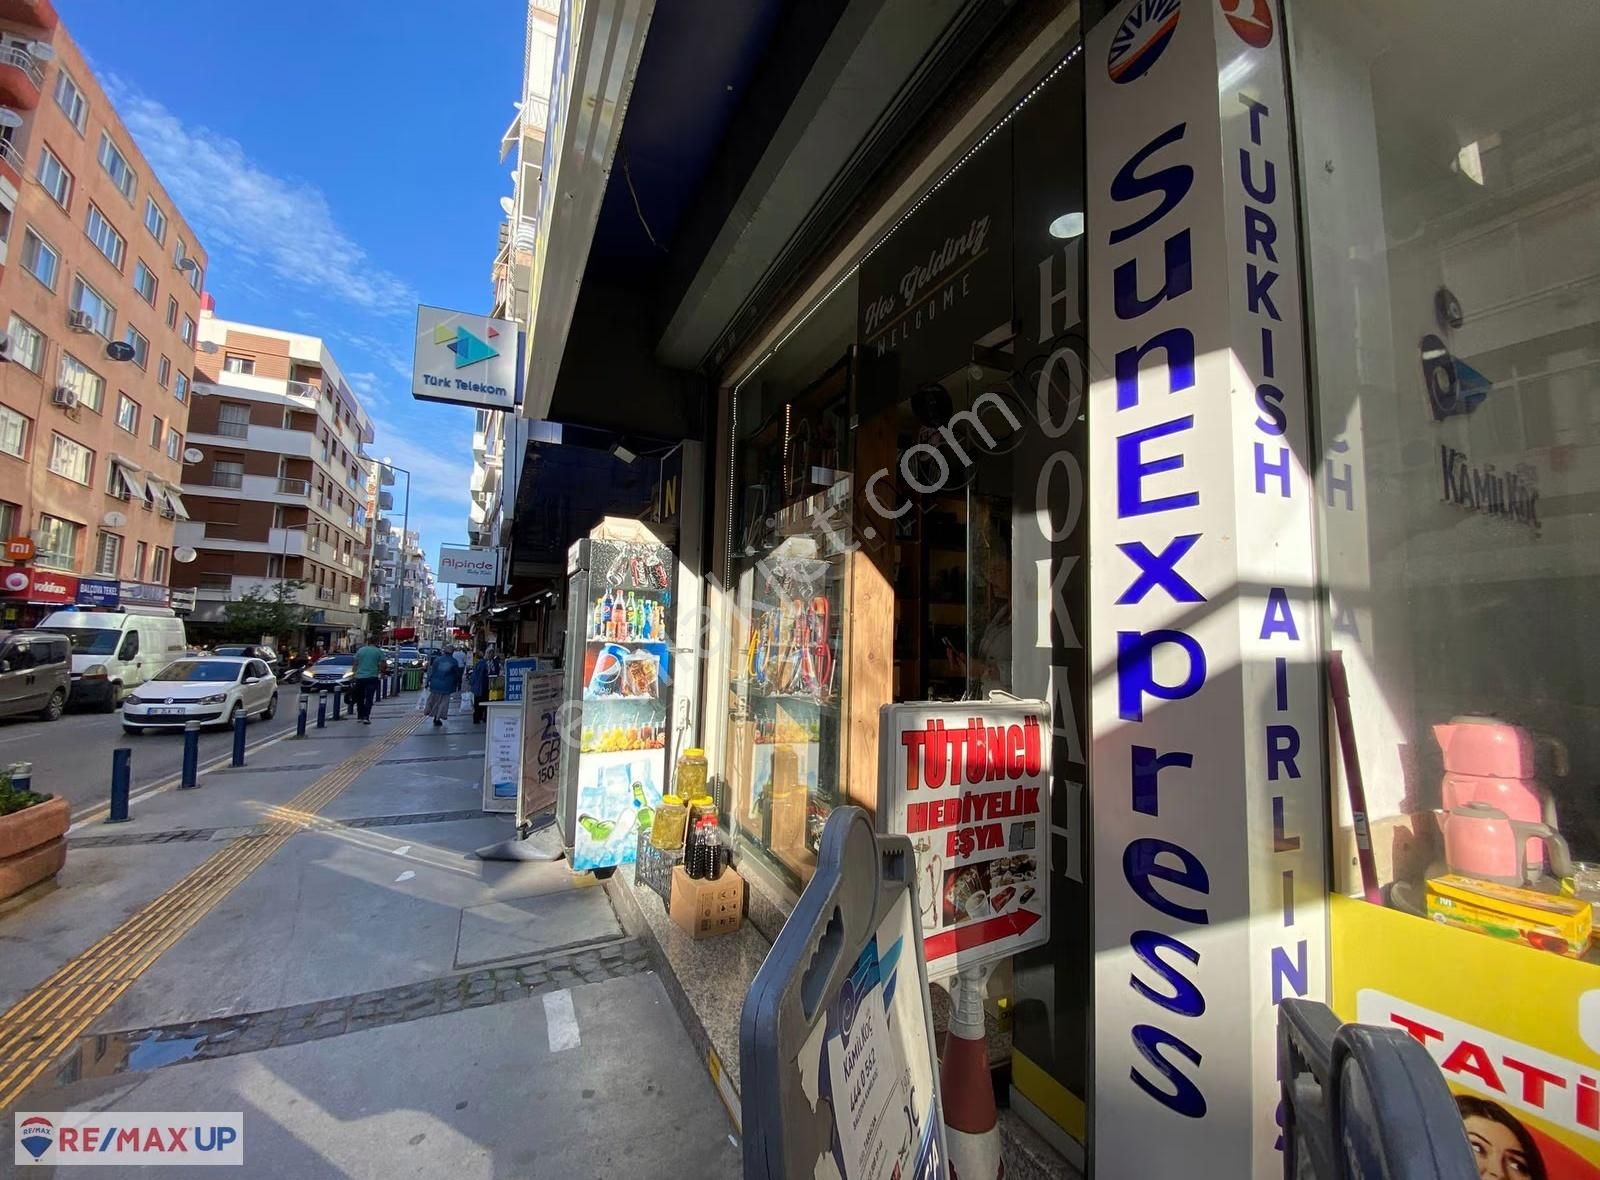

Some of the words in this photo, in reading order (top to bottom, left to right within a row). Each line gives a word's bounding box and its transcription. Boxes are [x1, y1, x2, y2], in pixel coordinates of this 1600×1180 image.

[877, 273, 970, 358] WELCOME
[1238, 92, 1291, 499] TURKISH
[423, 374, 451, 388] Türk
[455, 379, 507, 396] Telekom
[34, 581, 66, 595] vodafone
[442, 557, 493, 570] Alpinde
[1035, 238, 1085, 884] HOOKAH
[1109, 121, 1209, 1119] SunExpress
[901, 715, 1041, 791] TÜTÜNCÜ
[906, 784, 1040, 834] HEDİYELİK
[945, 823, 1005, 858] EŞYA
[1259, 587, 1308, 1151] AIRLIN
